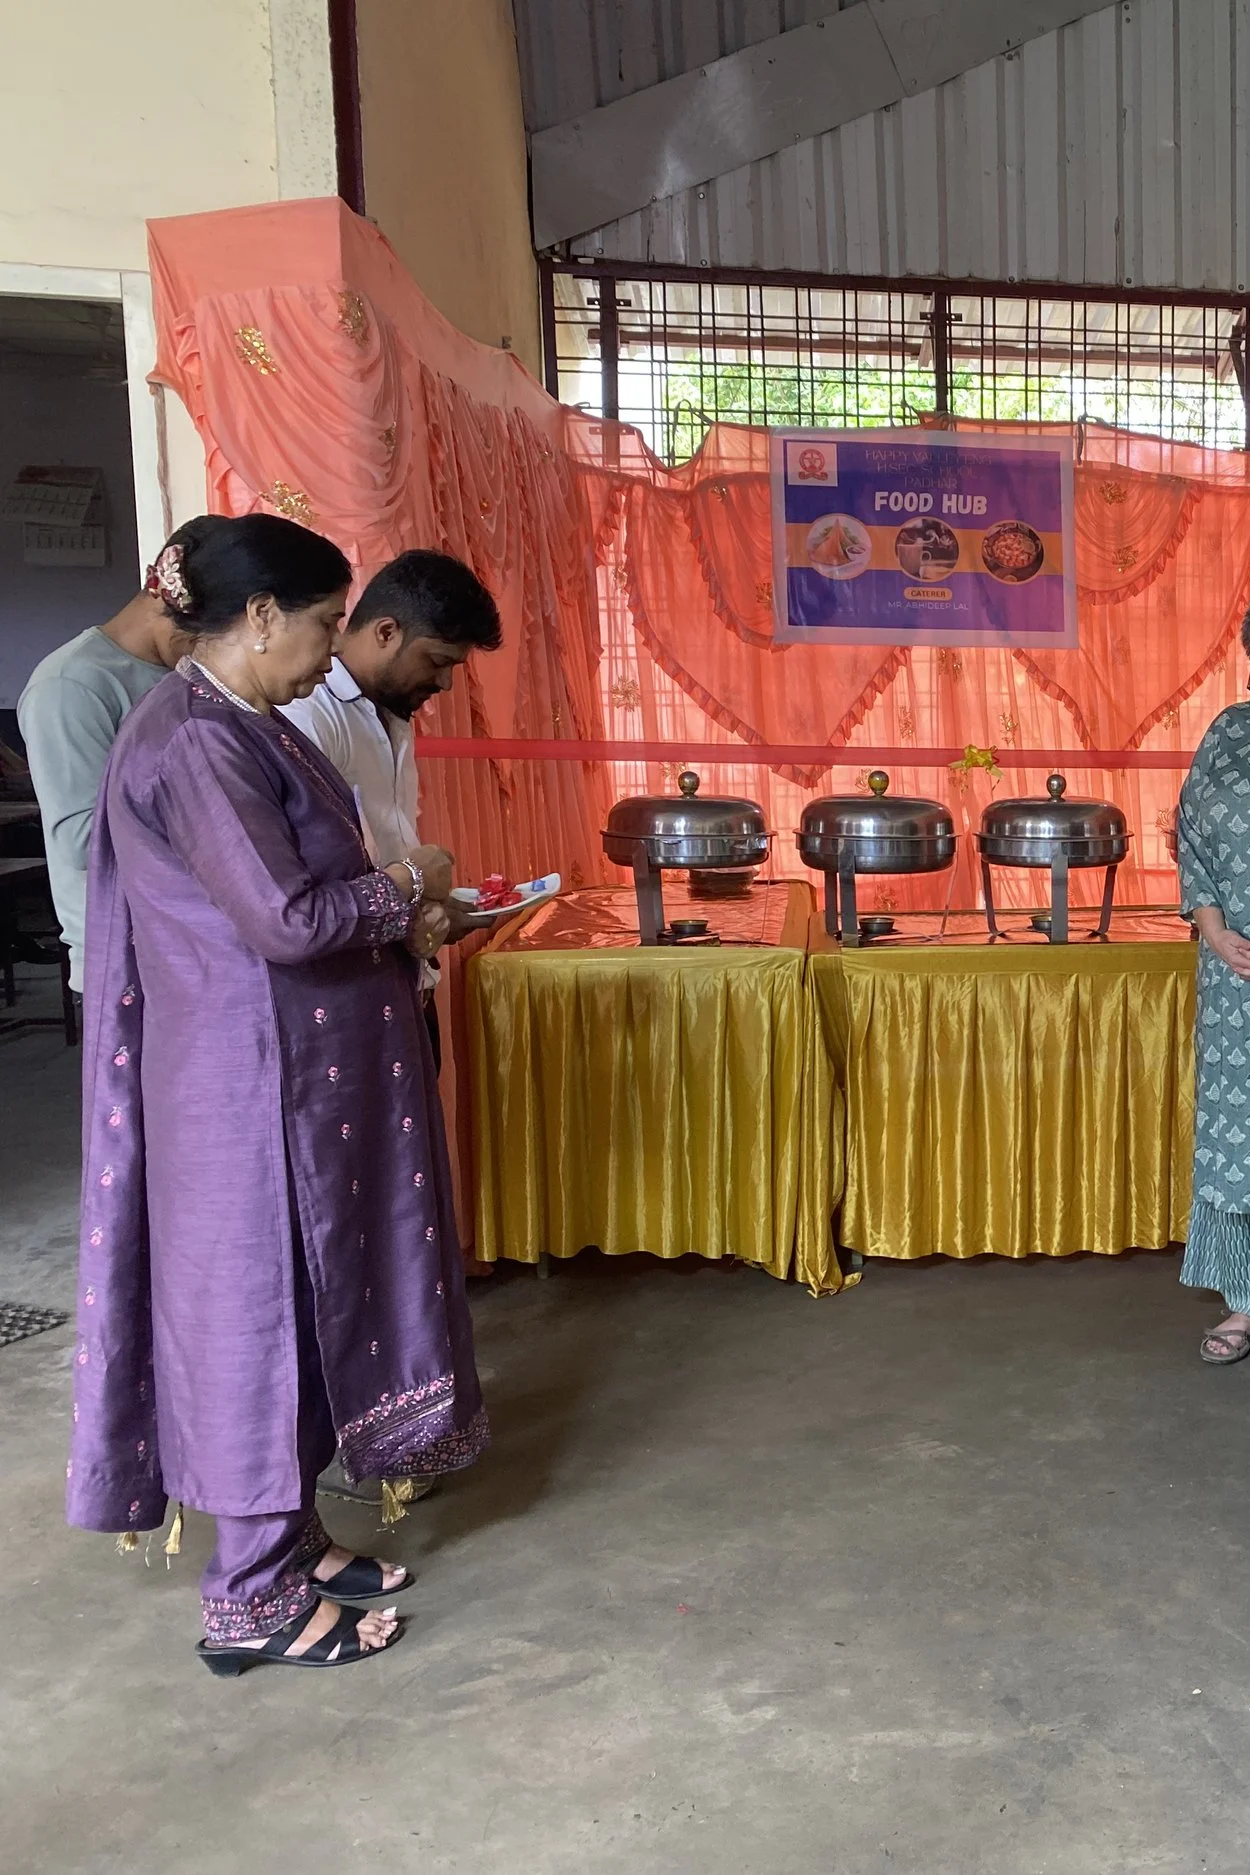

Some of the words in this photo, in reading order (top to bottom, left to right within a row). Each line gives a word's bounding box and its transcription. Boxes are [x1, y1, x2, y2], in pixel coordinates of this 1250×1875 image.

[866, 449, 908, 462] HAPPY
[874, 491, 934, 513] FOOD
[941, 493, 988, 515] HUB
[910, 590, 946, 598] CATERER
[953, 602, 969, 611] LAL
